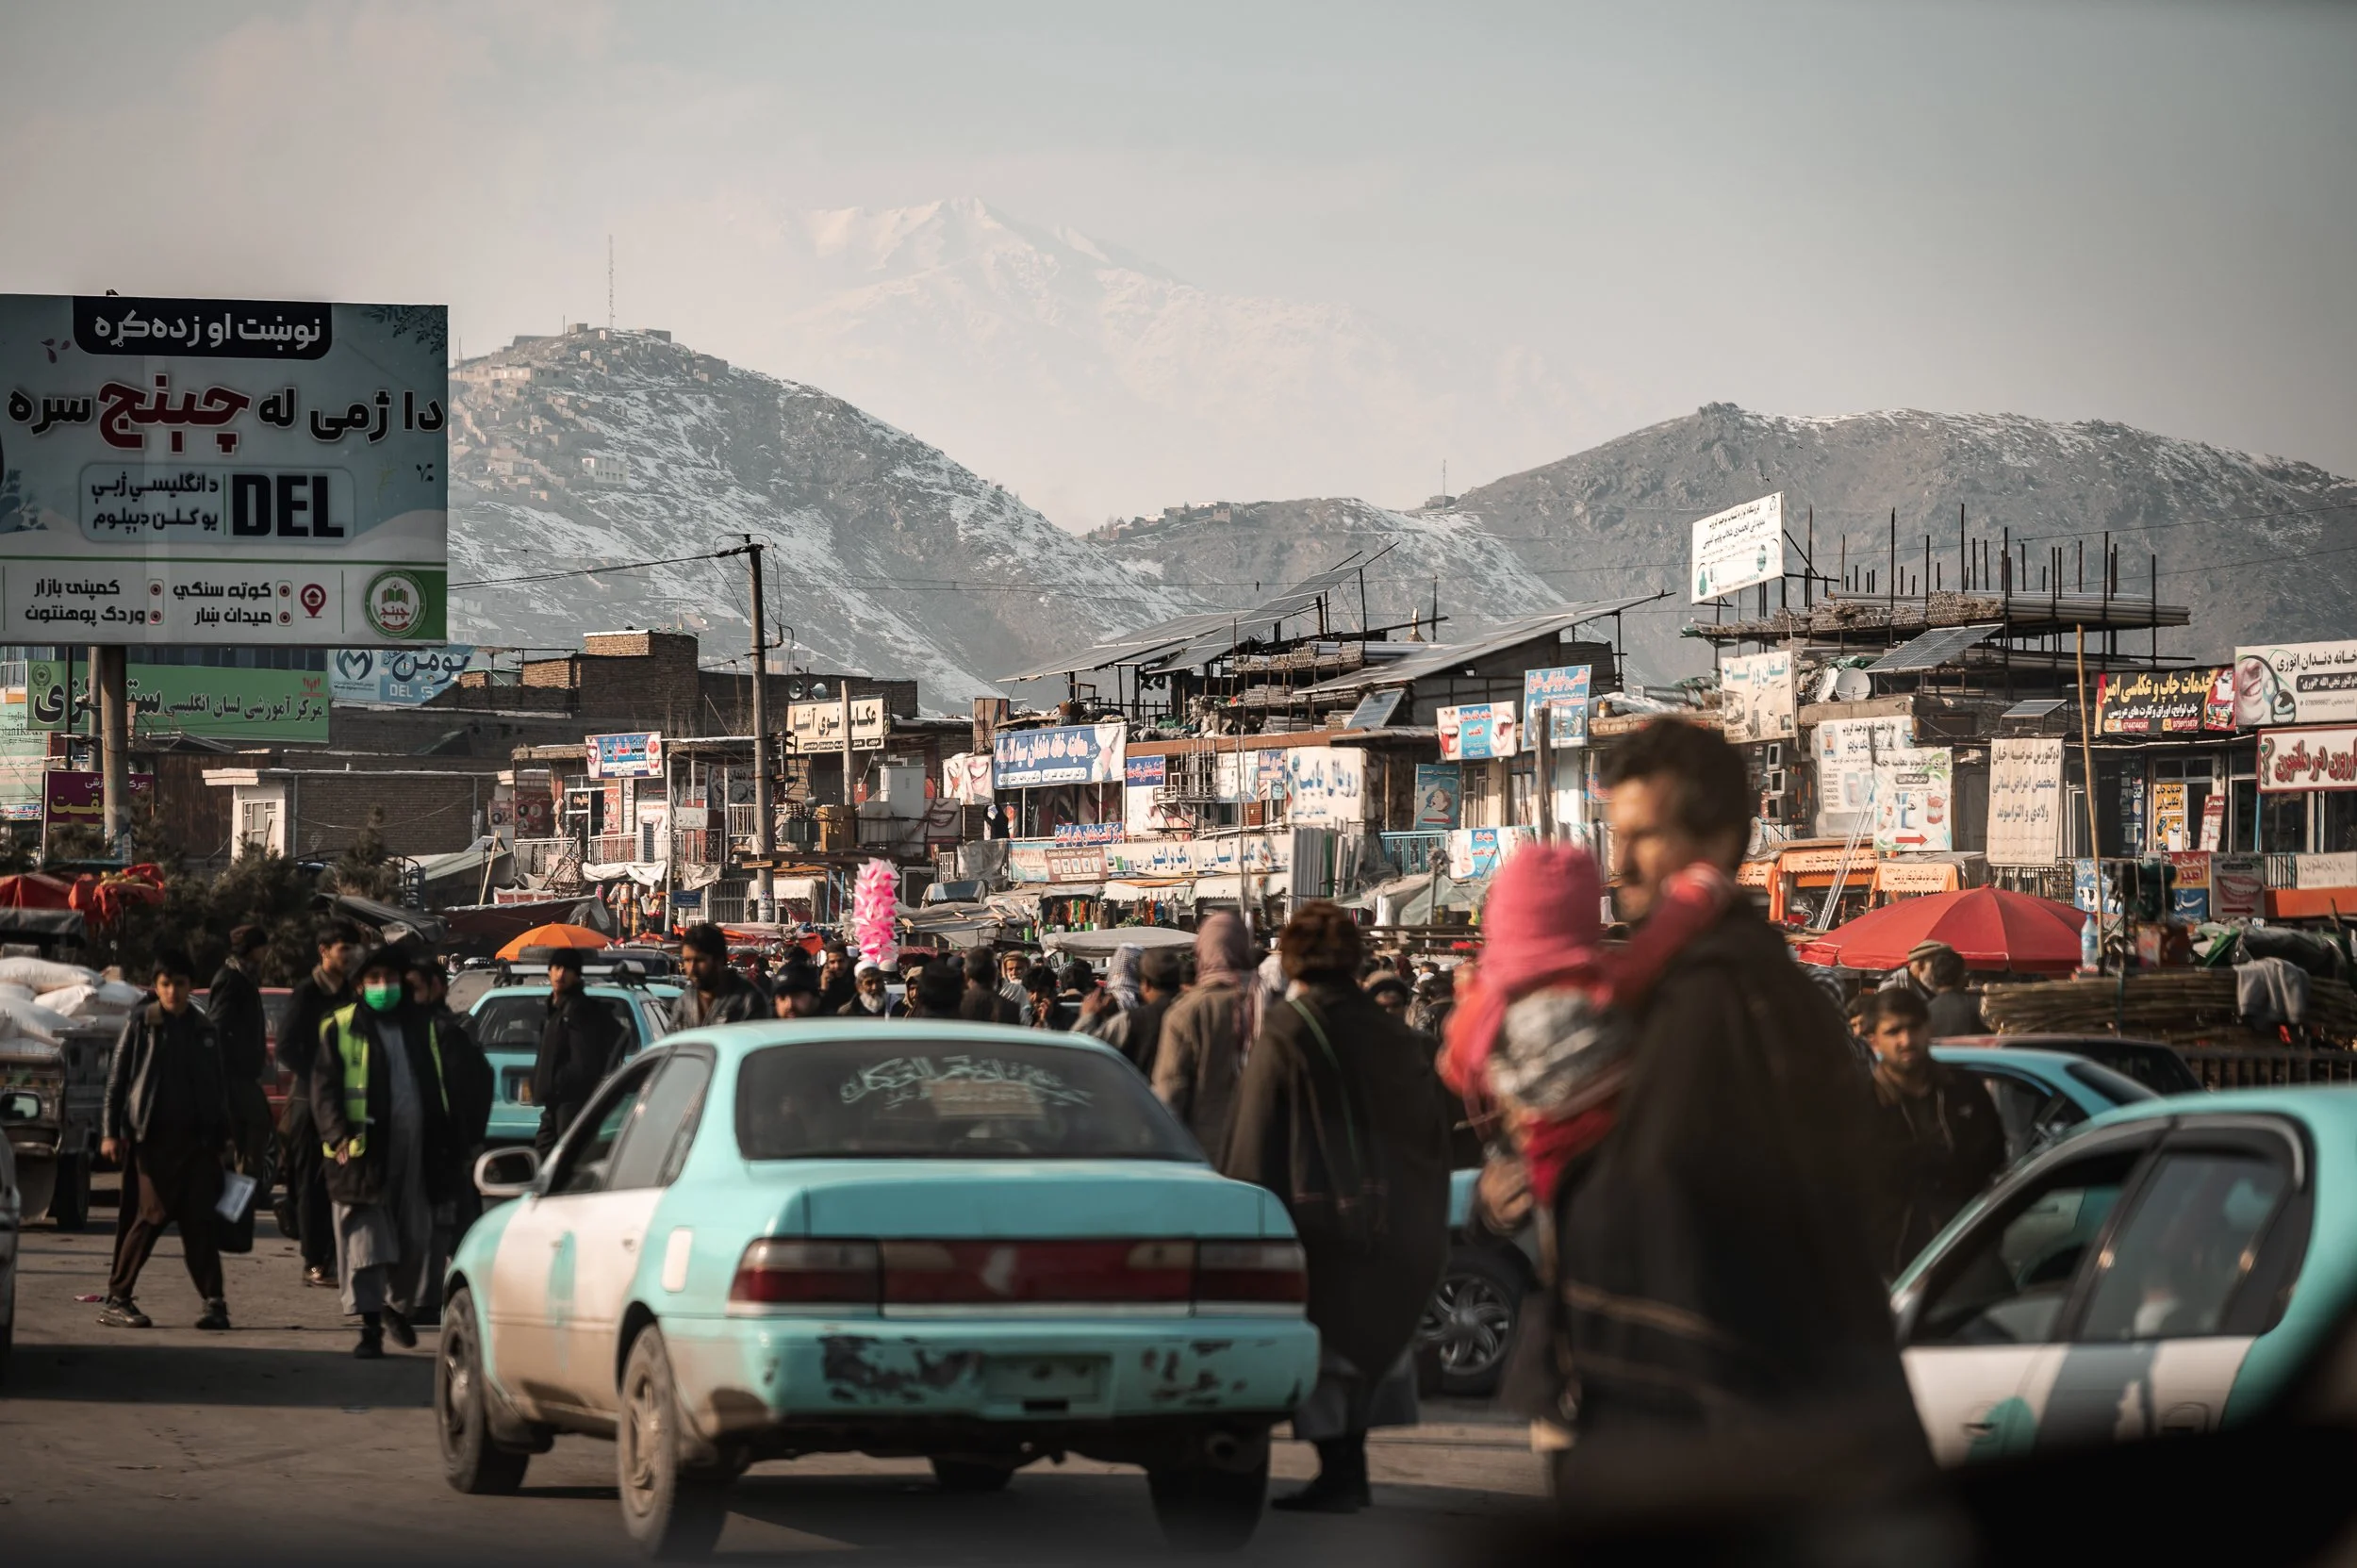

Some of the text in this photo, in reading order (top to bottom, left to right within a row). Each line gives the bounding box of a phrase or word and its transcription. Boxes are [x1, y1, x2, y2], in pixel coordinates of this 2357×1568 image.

[206, 312, 232, 348] او
[239, 314, 321, 351] نوښت
[8, 388, 93, 436] سره
[256, 387, 296, 428] له
[308, 388, 392, 444] ژمی
[402, 389, 444, 433] دا
[232, 474, 345, 537] DEL
[33, 578, 62, 598] بازار
[25, 604, 97, 628] پوهنتون
[193, 606, 272, 628] میدان ښار
[2276, 652, 2299, 672] انوری
[2300, 651, 2332, 671] دندان
[2102, 670, 2213, 704] خدمات چاپ و عکاسی امیر
[164, 693, 323, 723] مرکز آموزشی لسان انگلیسی
